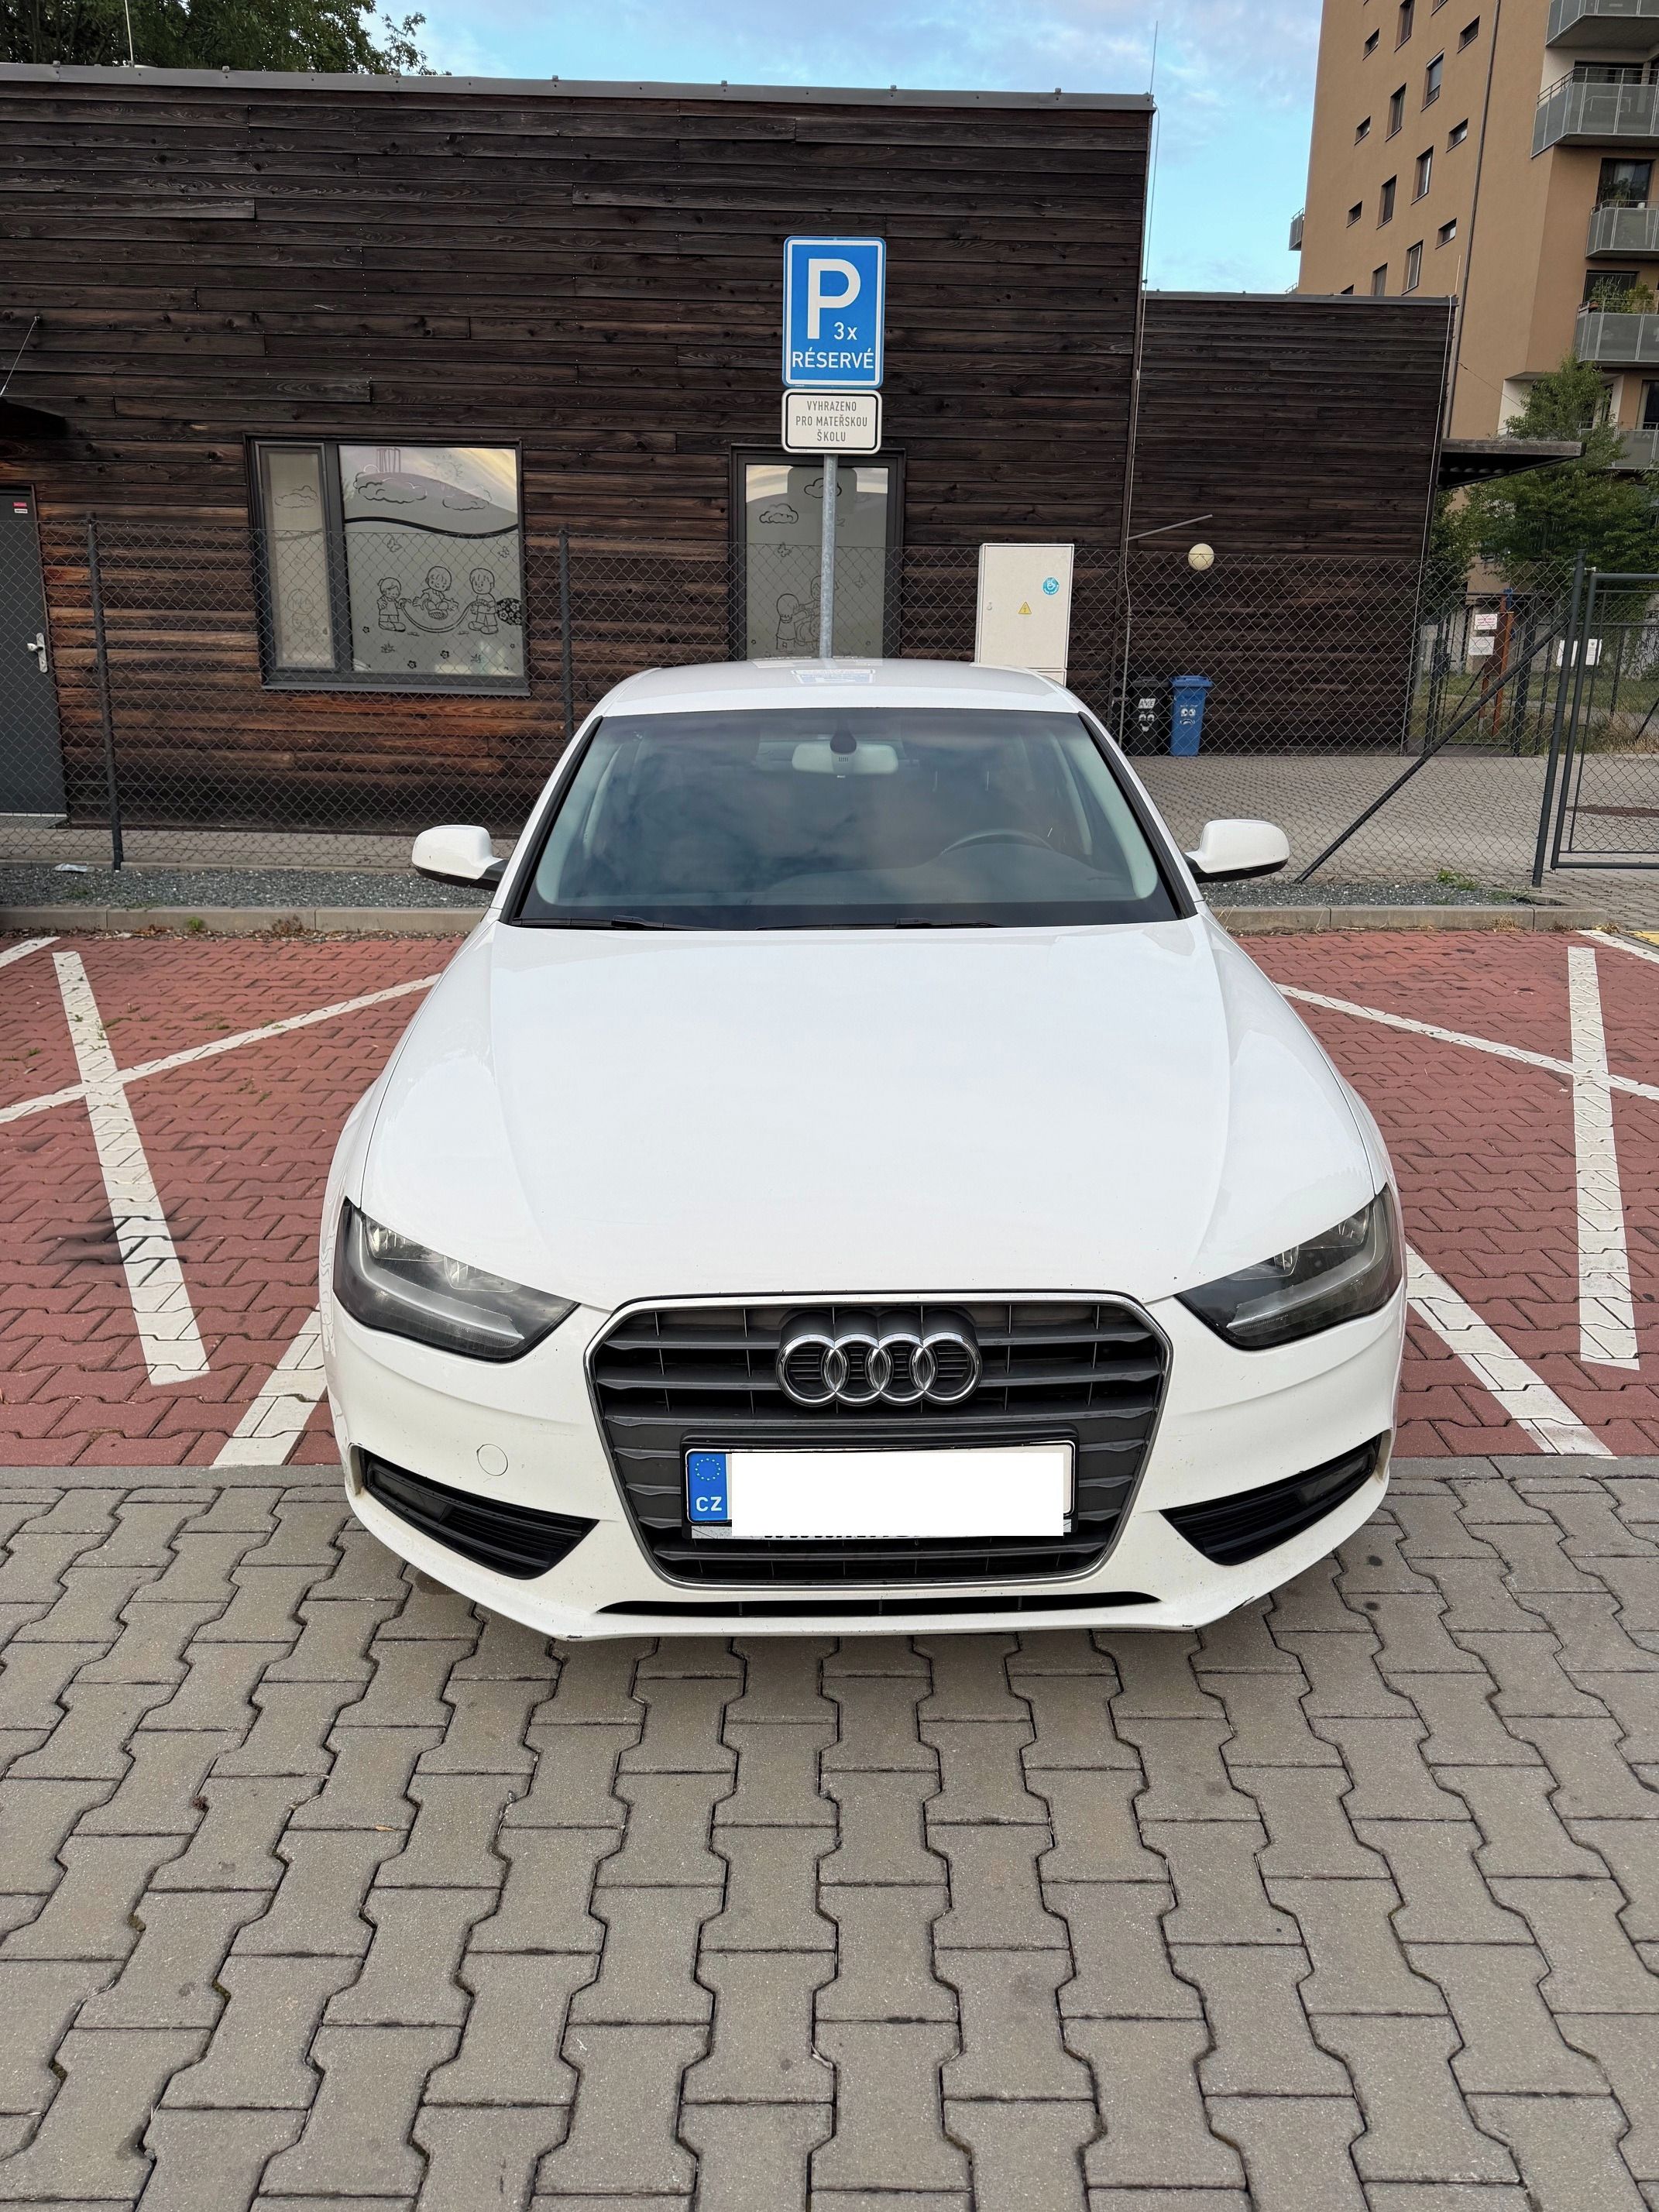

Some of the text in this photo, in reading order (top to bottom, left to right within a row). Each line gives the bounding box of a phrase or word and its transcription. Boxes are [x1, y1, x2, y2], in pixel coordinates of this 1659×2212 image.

[807, 258, 861, 339] P
[833, 321, 857, 340] 3x
[792, 347, 874, 369] RÉSERVÉ
[806, 400, 857, 412] VYHRAZENO
[795, 414, 867, 427] PRO MATEŘSKOU
[817, 428, 846, 442] ŠKOLU
[696, 1496, 722, 1512] CZ
